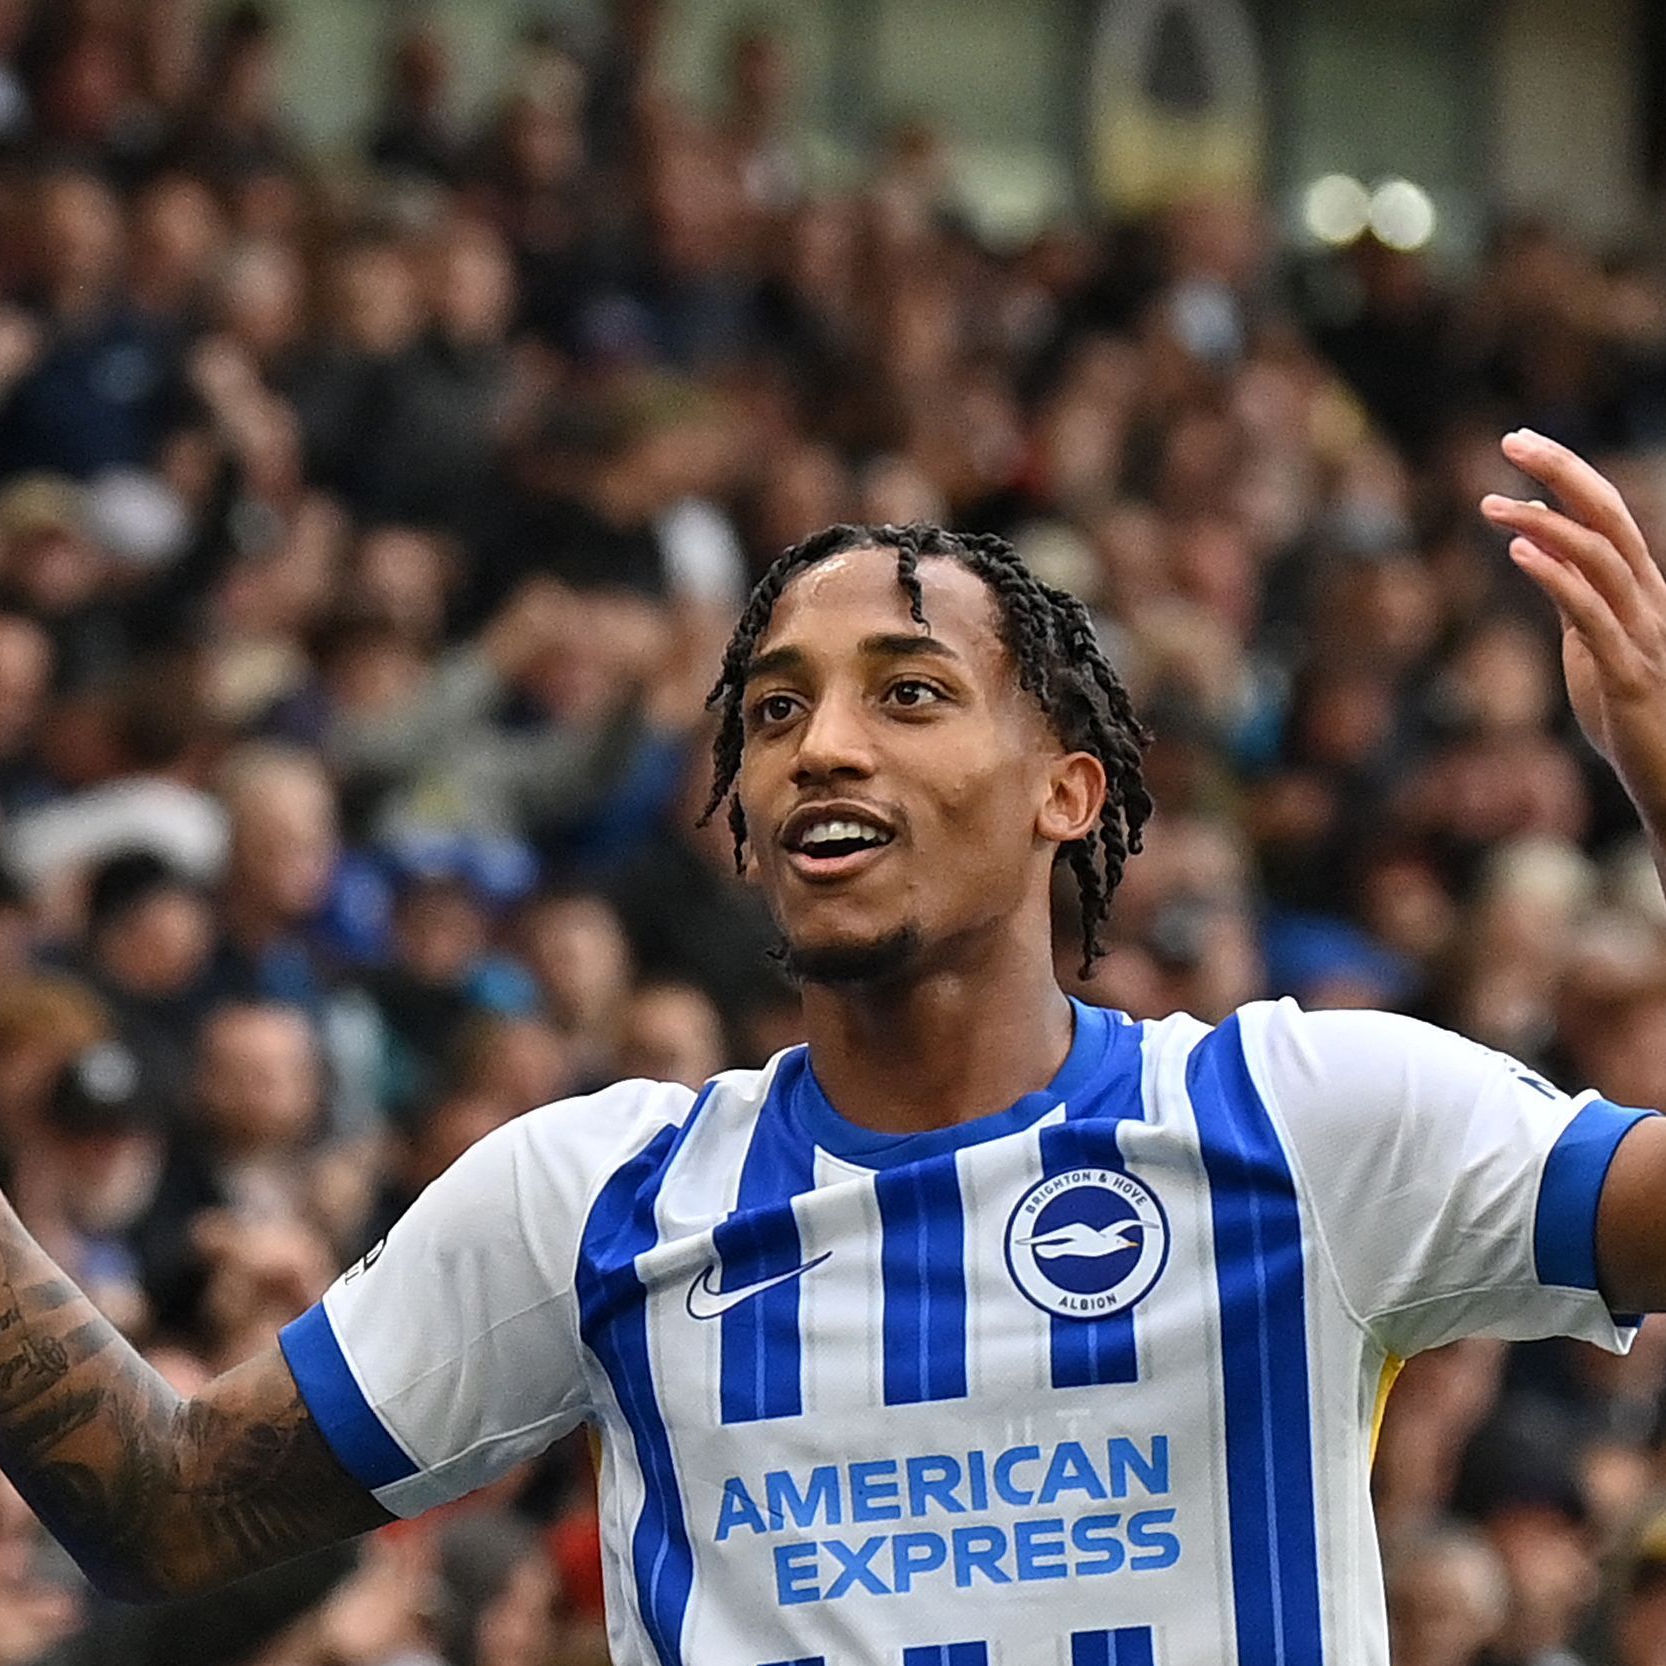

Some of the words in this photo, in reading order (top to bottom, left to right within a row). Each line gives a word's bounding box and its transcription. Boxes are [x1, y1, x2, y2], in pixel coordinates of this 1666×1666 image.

[1025, 1172, 1091, 1214] BRIGHTON
[1098, 1173, 1107, 1183] &
[1113, 1177, 1148, 1207] HOVE
[1058, 1293, 1118, 1310] ALBION
[713, 1435, 1168, 1541] AMERICAN
[772, 1508, 1181, 1605] EXPRESS
